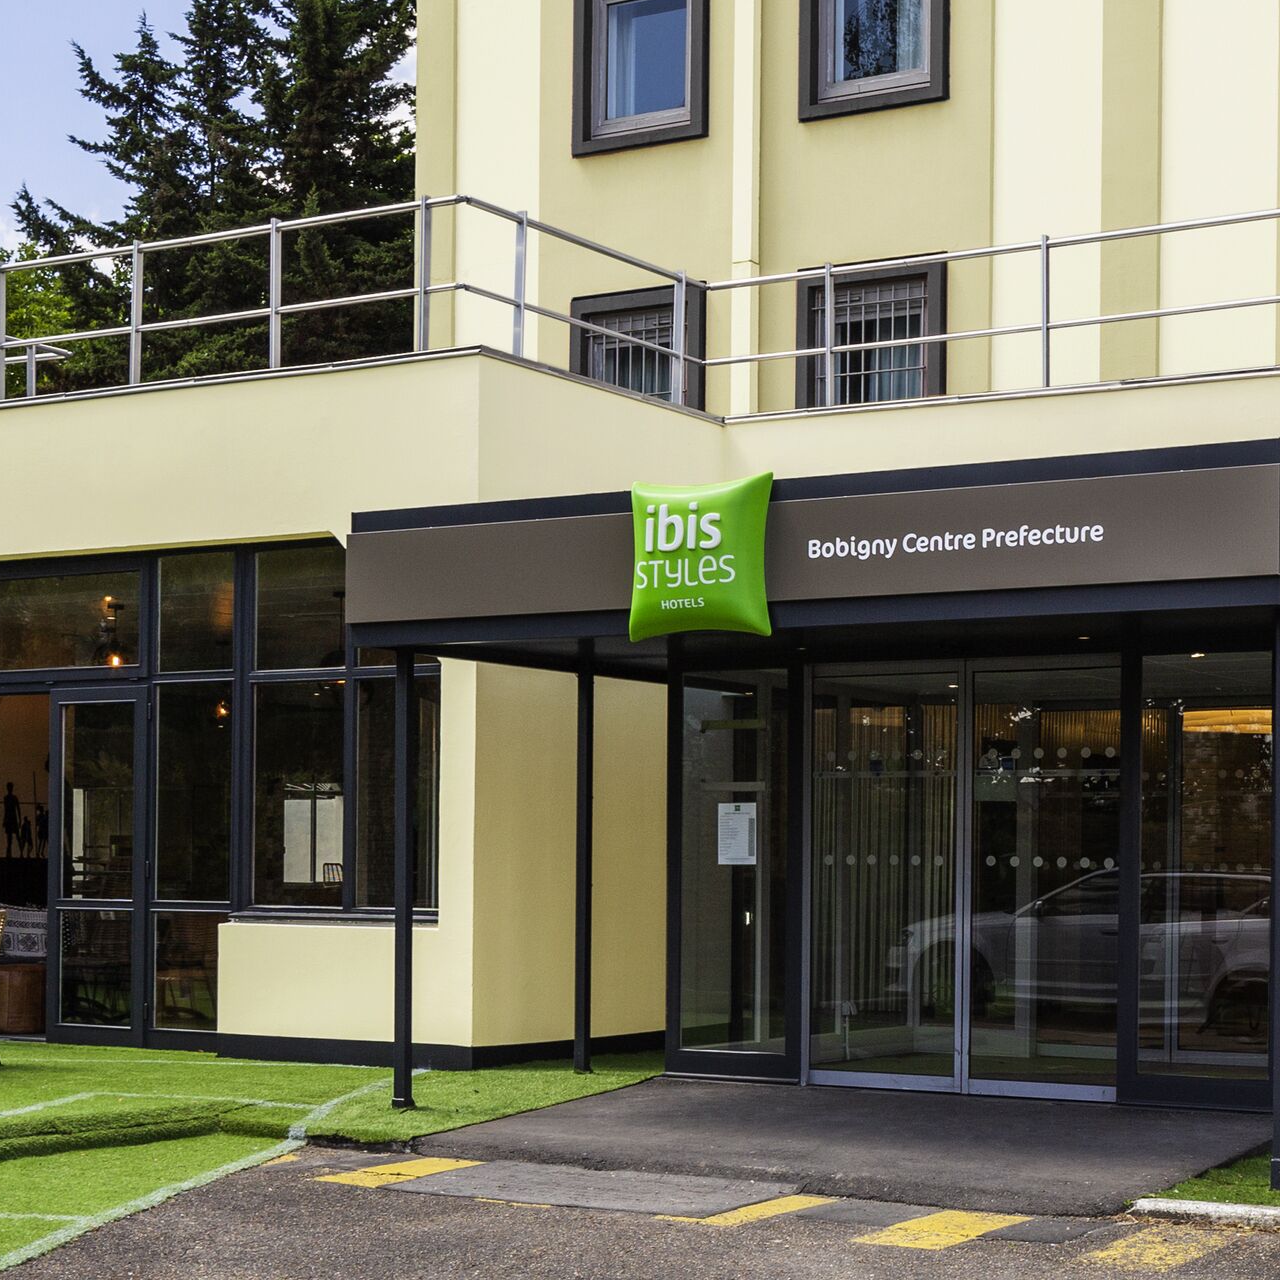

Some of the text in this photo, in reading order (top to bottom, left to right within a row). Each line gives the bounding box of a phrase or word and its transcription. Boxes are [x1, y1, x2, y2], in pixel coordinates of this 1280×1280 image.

[644, 501, 722, 553] ibis
[807, 524, 1104, 560] Bobigny Centre Prefecture
[661, 597, 705, 610] HOTELS
